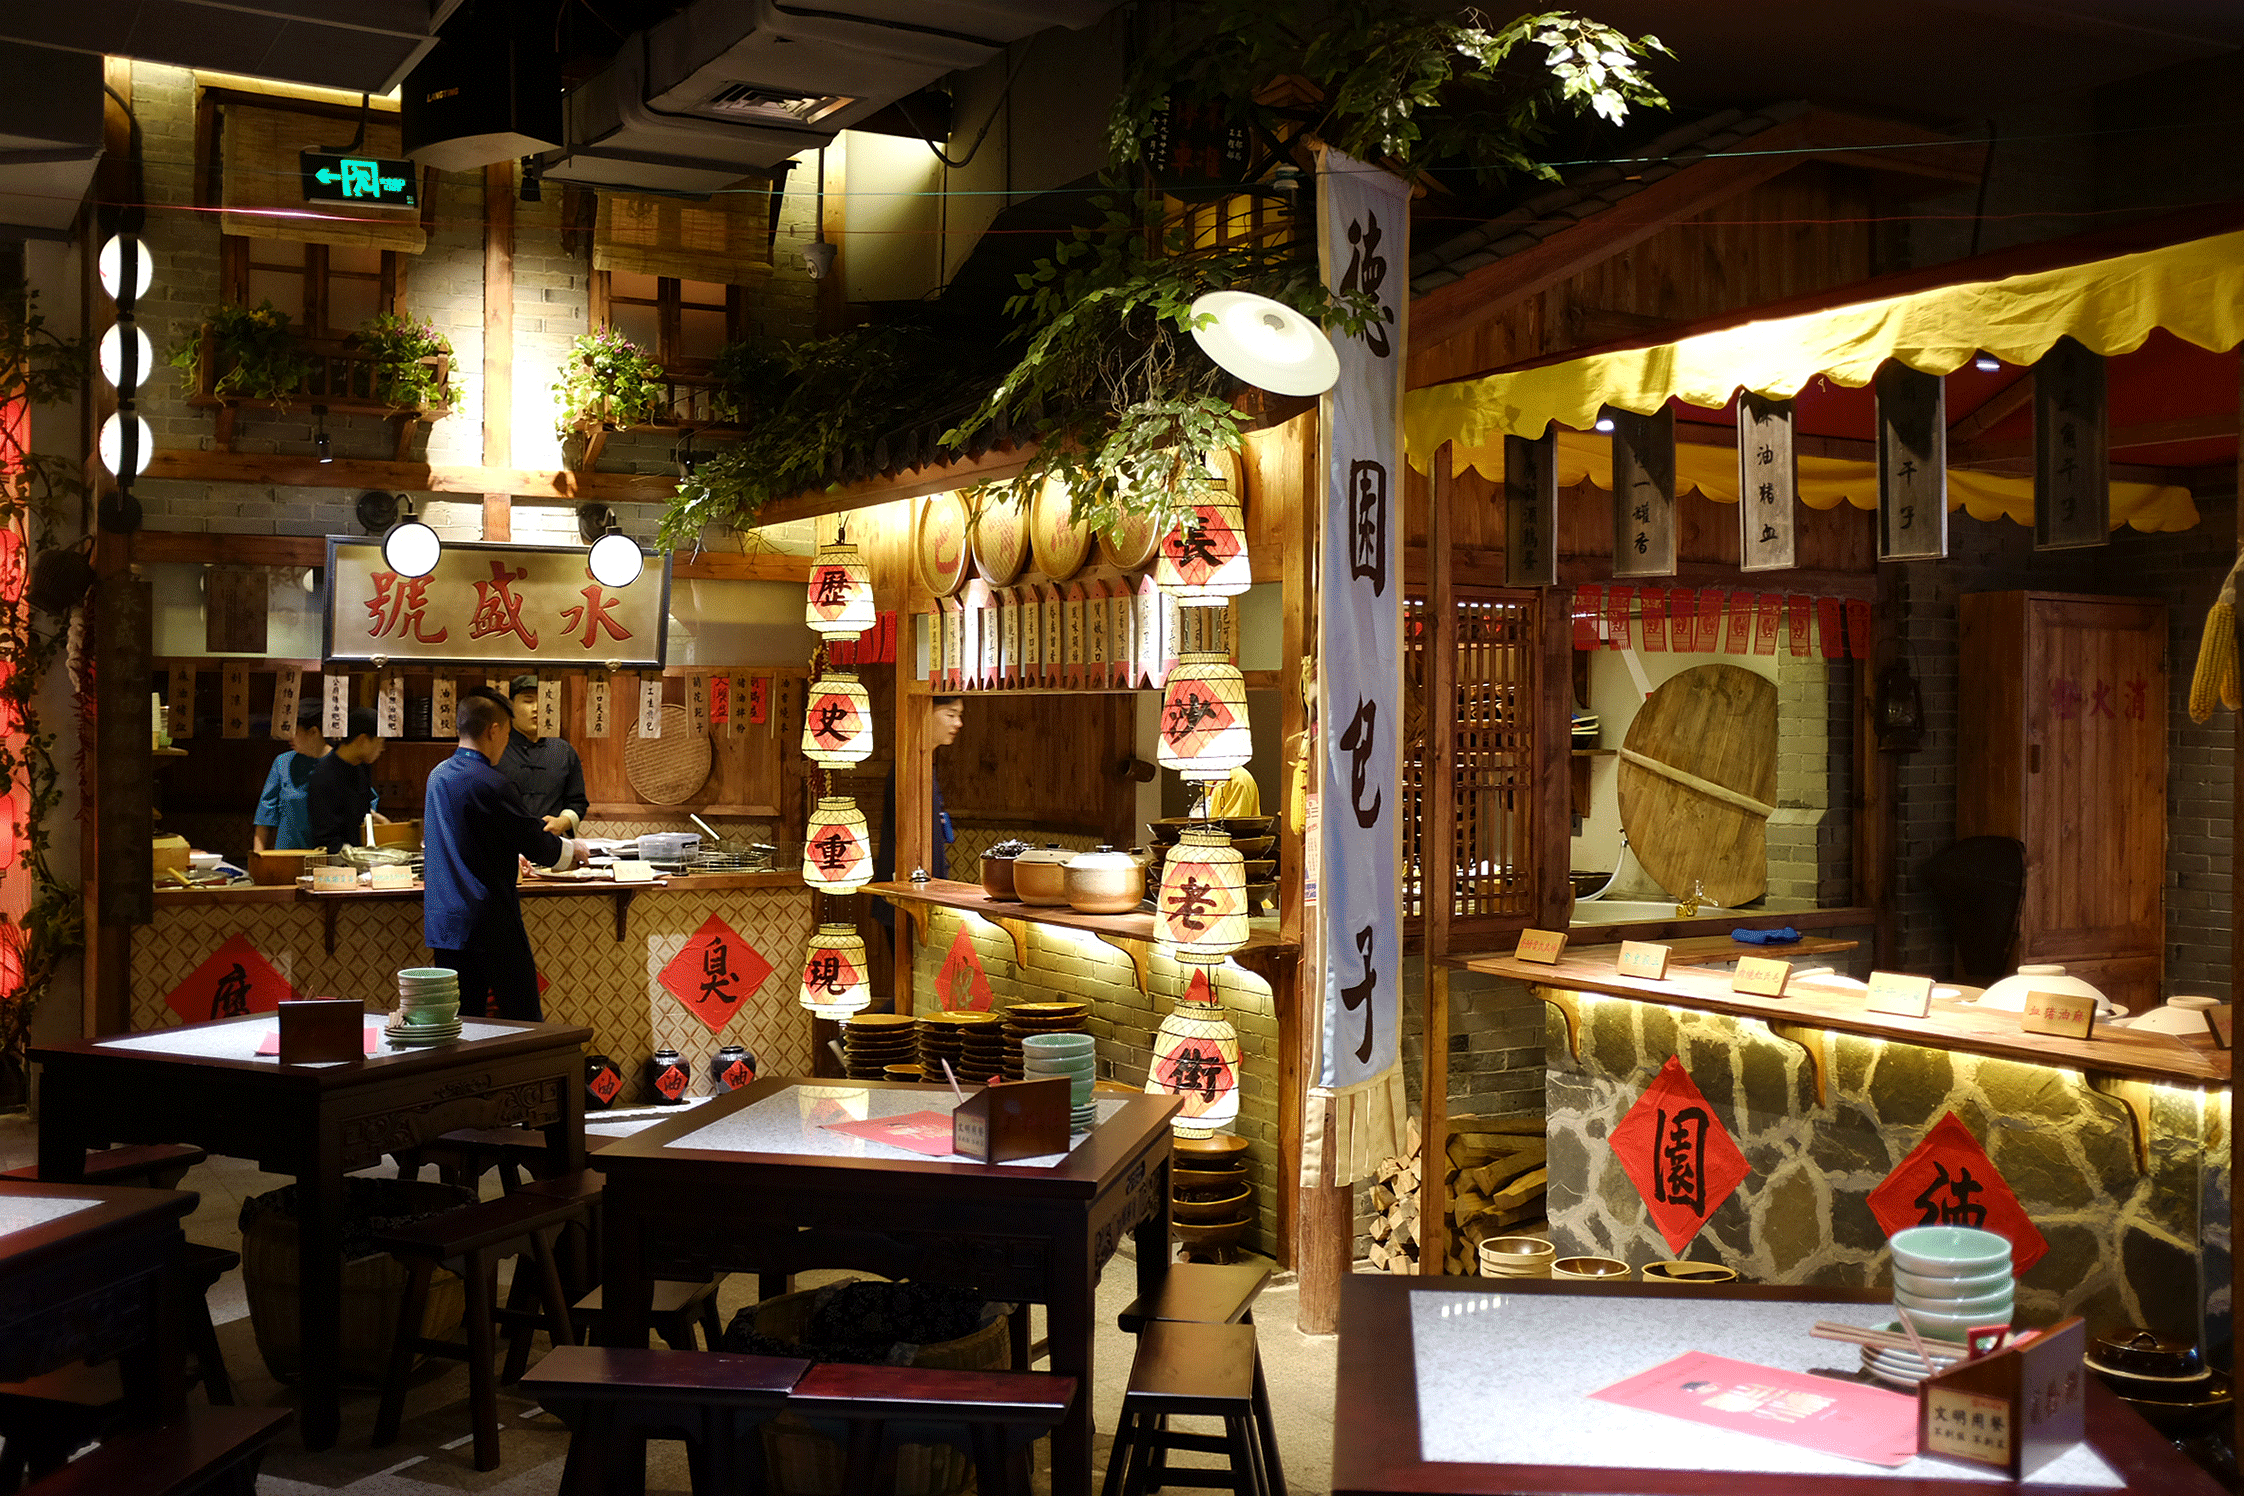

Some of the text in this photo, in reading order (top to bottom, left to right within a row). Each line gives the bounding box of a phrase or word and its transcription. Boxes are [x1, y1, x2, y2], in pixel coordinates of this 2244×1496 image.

[813, 702, 851, 742] 史
[815, 833, 852, 870] 重
[1167, 876, 1217, 930] 老
[697, 937, 738, 1004] 臭
[598, 1073, 615, 1096] 油
[663, 1070, 682, 1092] 油
[729, 1064, 749, 1087] 油
[1169, 1048, 1222, 1103] 街
